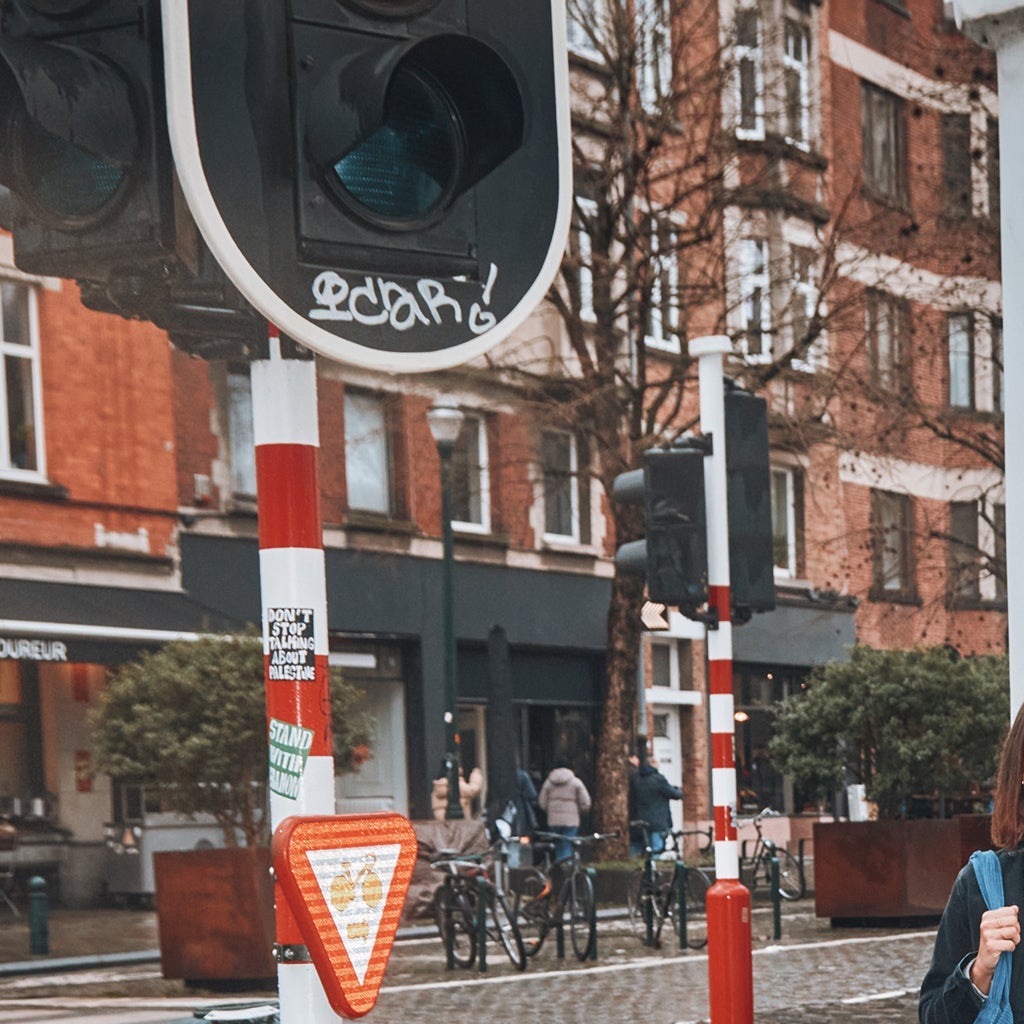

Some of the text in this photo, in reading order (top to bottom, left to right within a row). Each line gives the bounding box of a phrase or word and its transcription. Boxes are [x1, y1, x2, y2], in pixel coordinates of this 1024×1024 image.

[268, 608, 312, 623] DON'T
[271, 622, 307, 636] STOP
[271, 650, 308, 665] ABOUT
[269, 719, 313, 750] STAND
